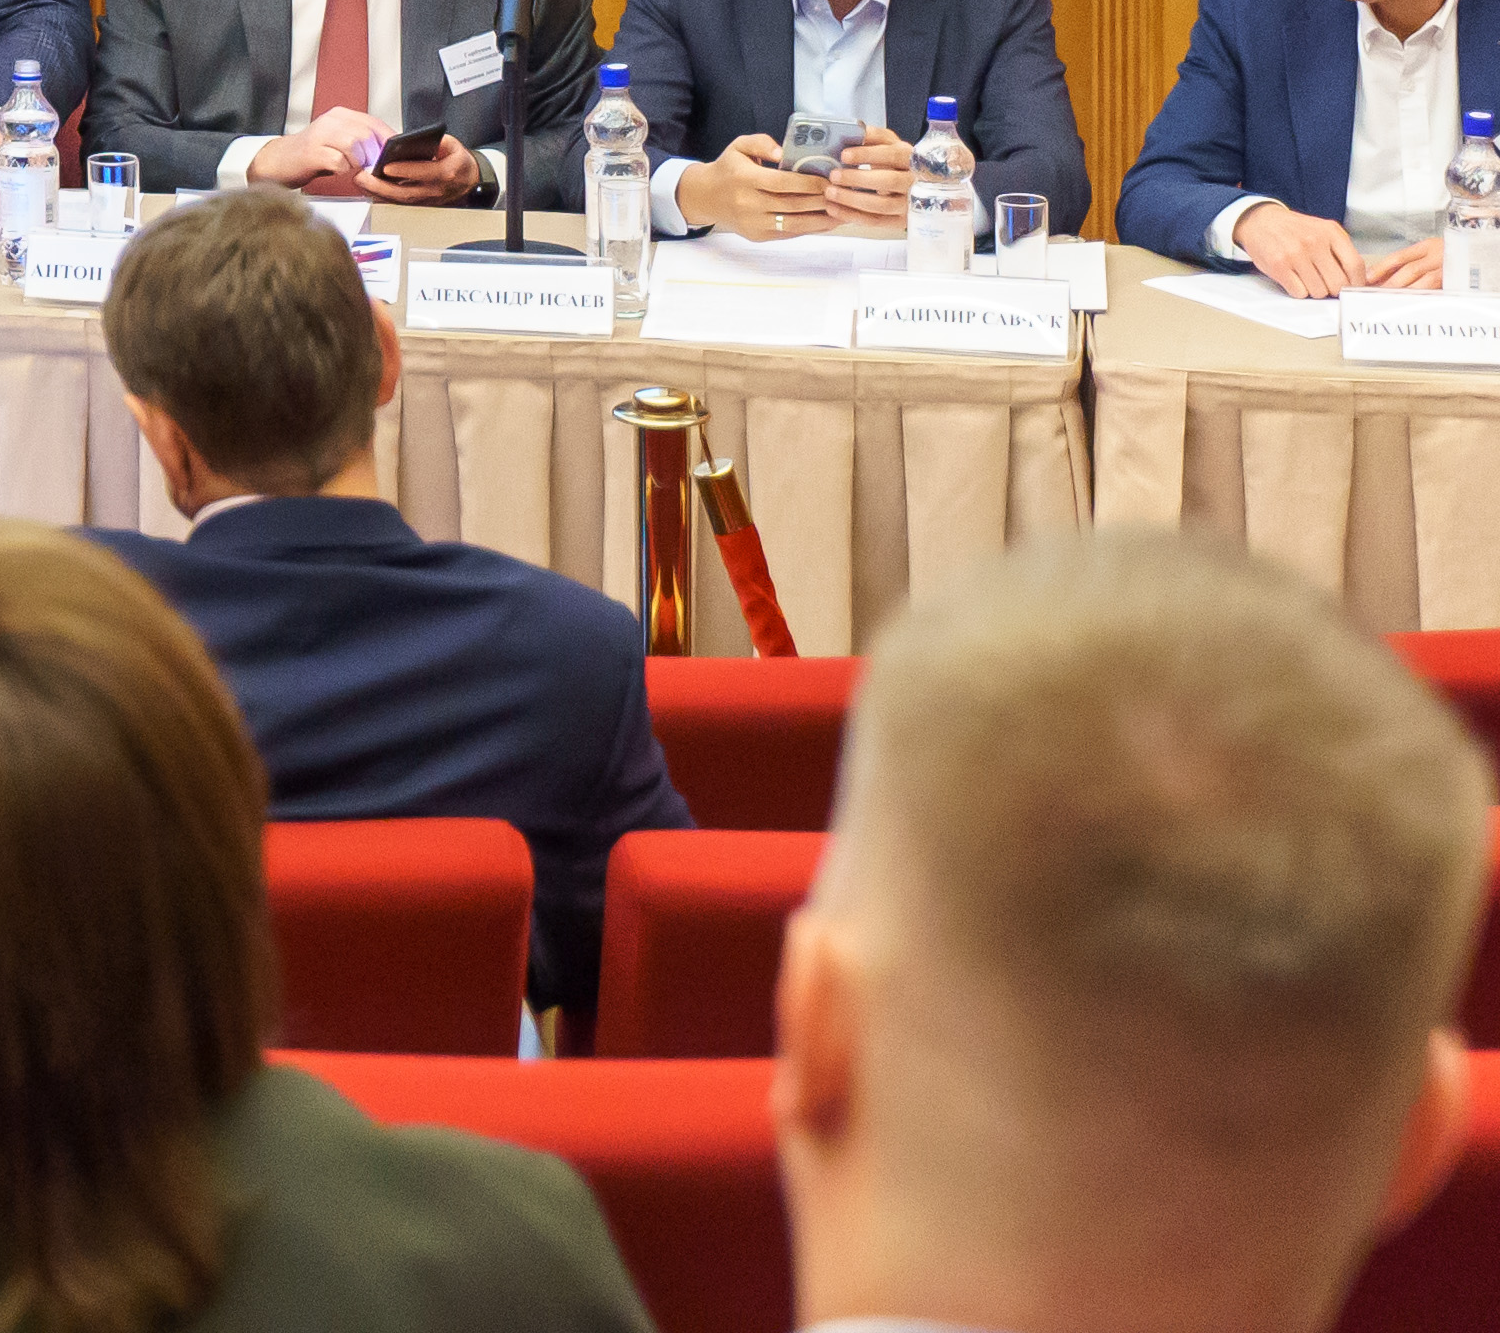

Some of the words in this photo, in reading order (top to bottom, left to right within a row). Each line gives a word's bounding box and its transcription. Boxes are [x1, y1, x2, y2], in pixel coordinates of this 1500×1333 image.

[31, 263, 103, 281] АНТОН
[414, 287, 534, 307] АЛЕКСАНДР
[539, 293, 605, 309] ИСАЕВ
[1348, 321, 1433, 337] МИХАИЛ
